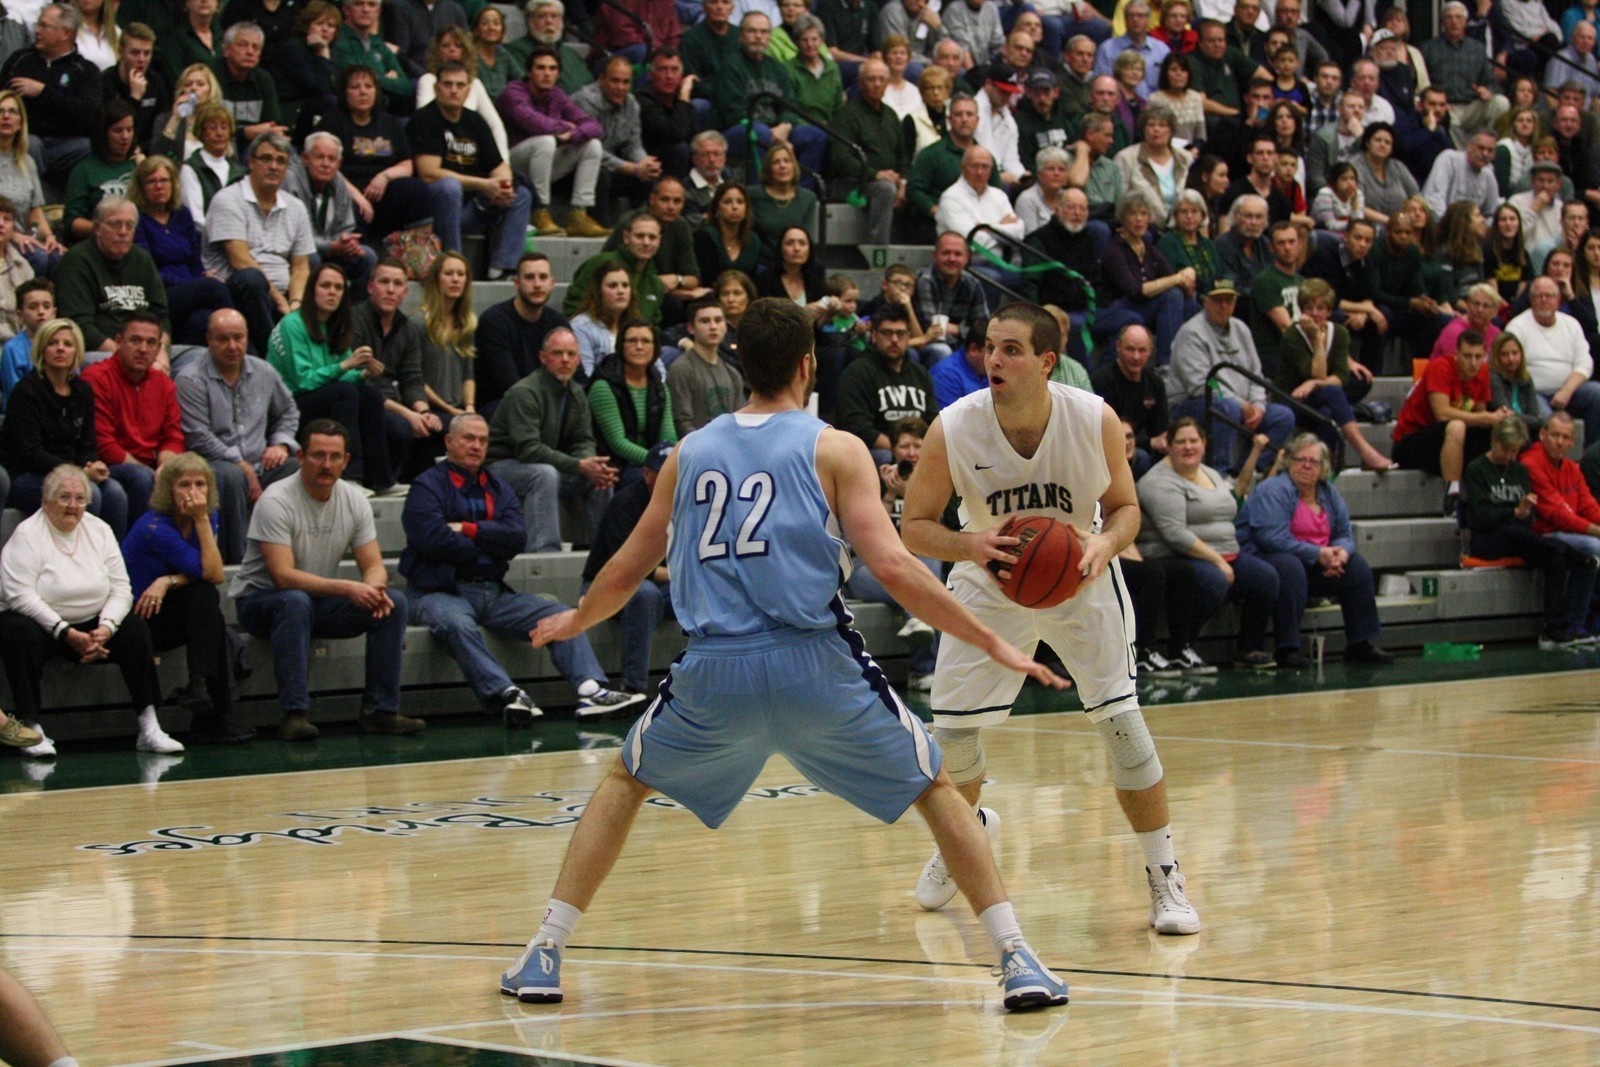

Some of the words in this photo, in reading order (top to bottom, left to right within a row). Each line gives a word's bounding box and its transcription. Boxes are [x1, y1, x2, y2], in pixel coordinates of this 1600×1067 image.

[878, 384, 927, 412] IWU
[694, 468, 776, 564] 22
[986, 482, 1073, 516] TITANS
